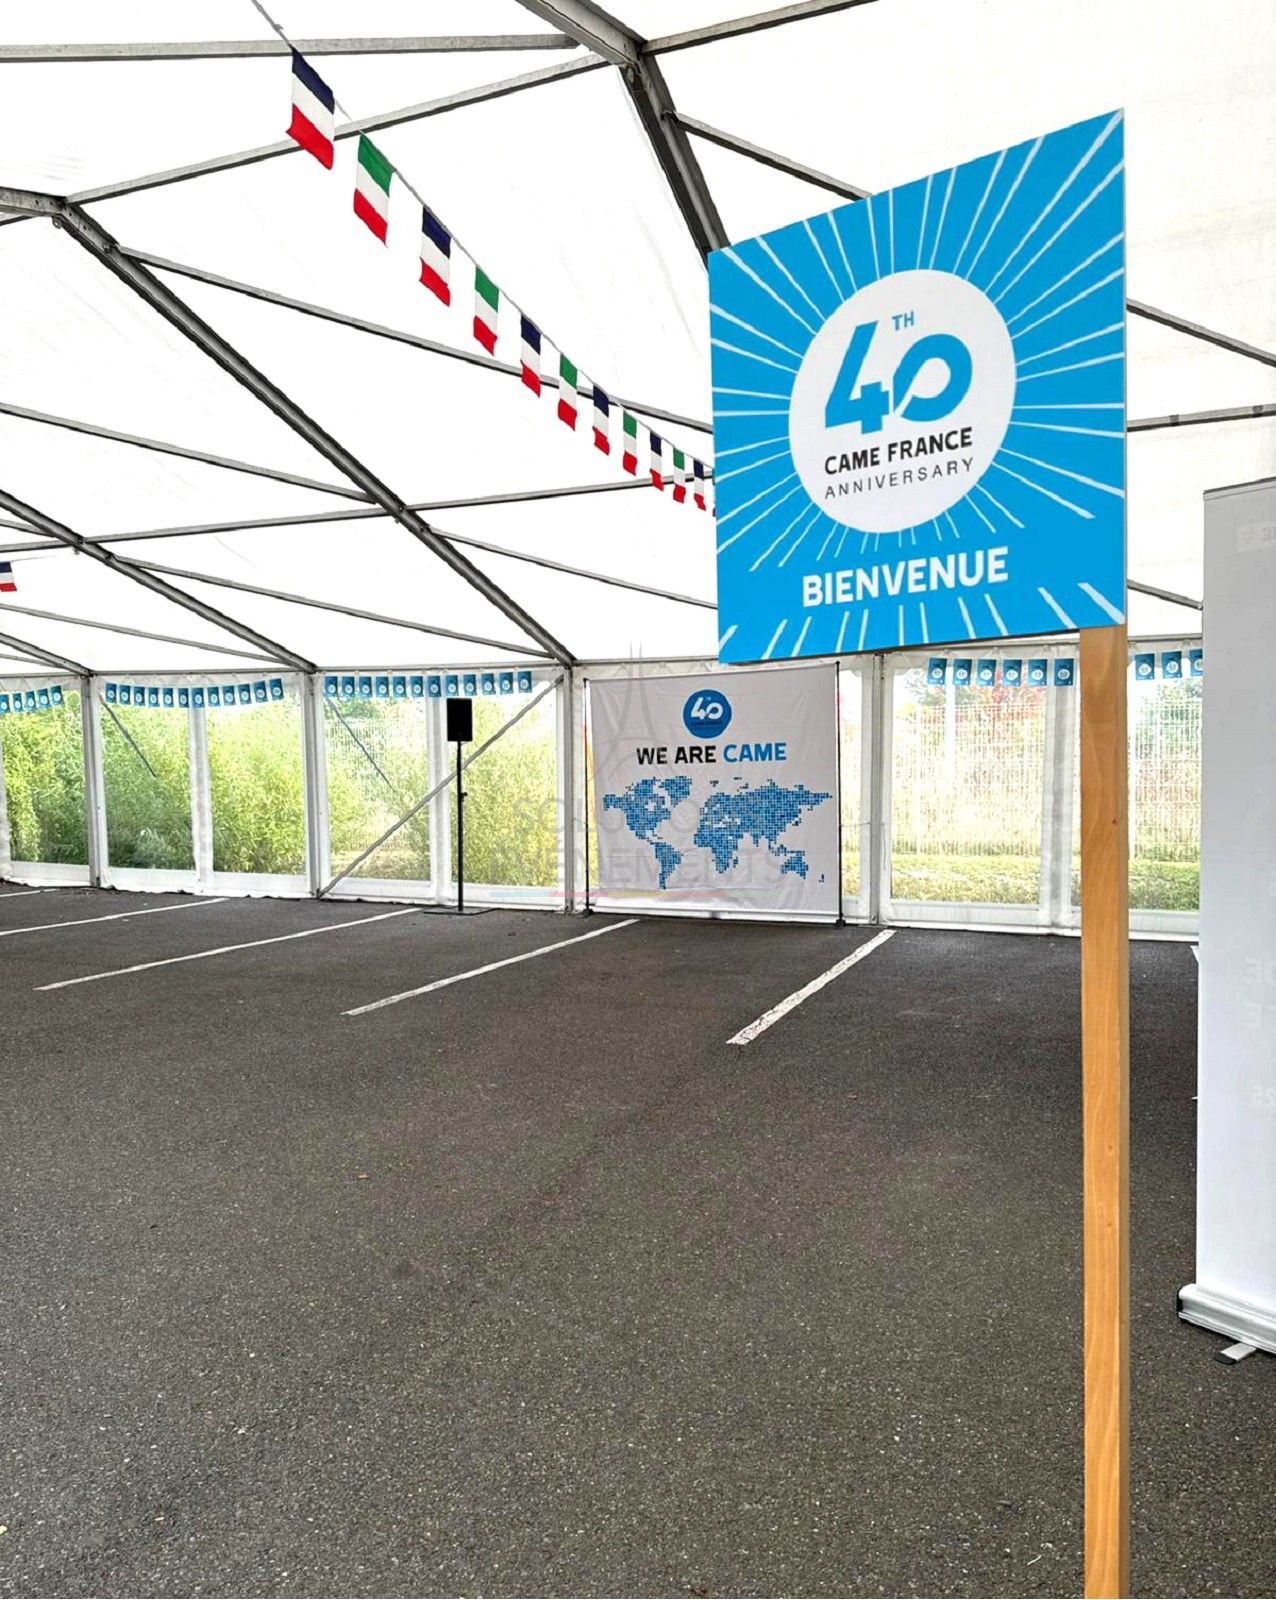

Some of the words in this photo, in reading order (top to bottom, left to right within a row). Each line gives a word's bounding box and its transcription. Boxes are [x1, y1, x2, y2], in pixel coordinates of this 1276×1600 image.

[891, 311, 915, 332] TH
[824, 320, 973, 435] 40
[824, 444, 880, 476] CAME
[888, 426, 973, 464] FRANCE
[824, 457, 975, 500] ANNIVERSARY
[802, 546, 1009, 608] BIENVENUE
[636, 747, 668, 766] WE
[674, 745, 717, 765] ARE
[722, 742, 788, 764] CAME
